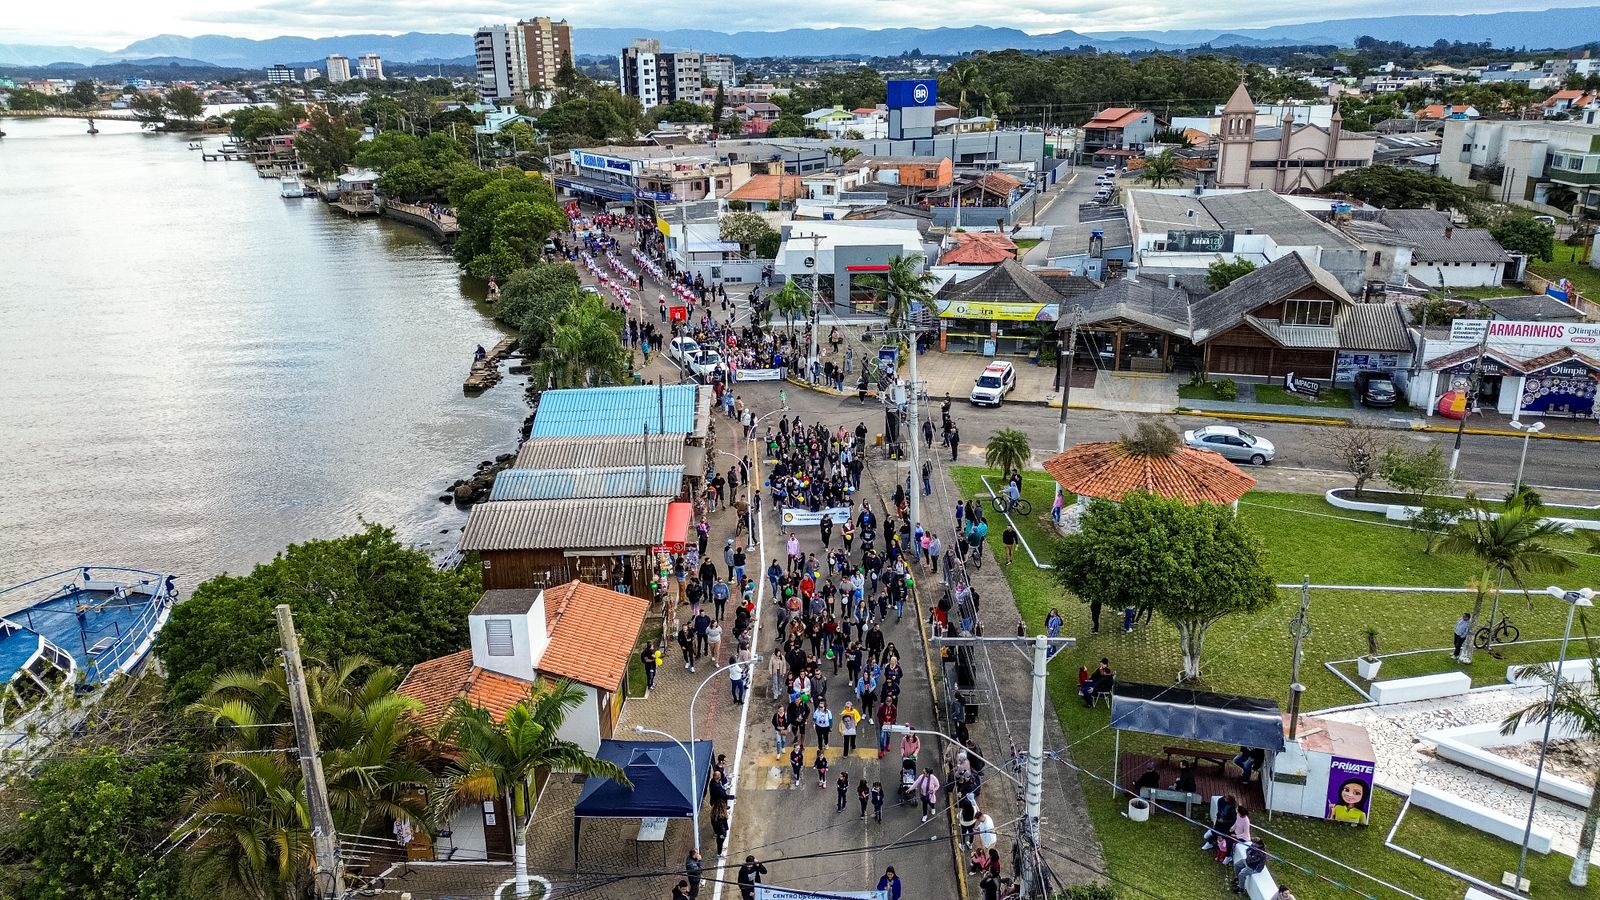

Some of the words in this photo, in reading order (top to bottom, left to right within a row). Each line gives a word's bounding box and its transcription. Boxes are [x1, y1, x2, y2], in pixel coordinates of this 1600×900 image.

[915, 89, 926, 98] BR
[1489, 323, 1564, 338] ARMARINHOS
[1294, 379, 1319, 390] IMPACTO
